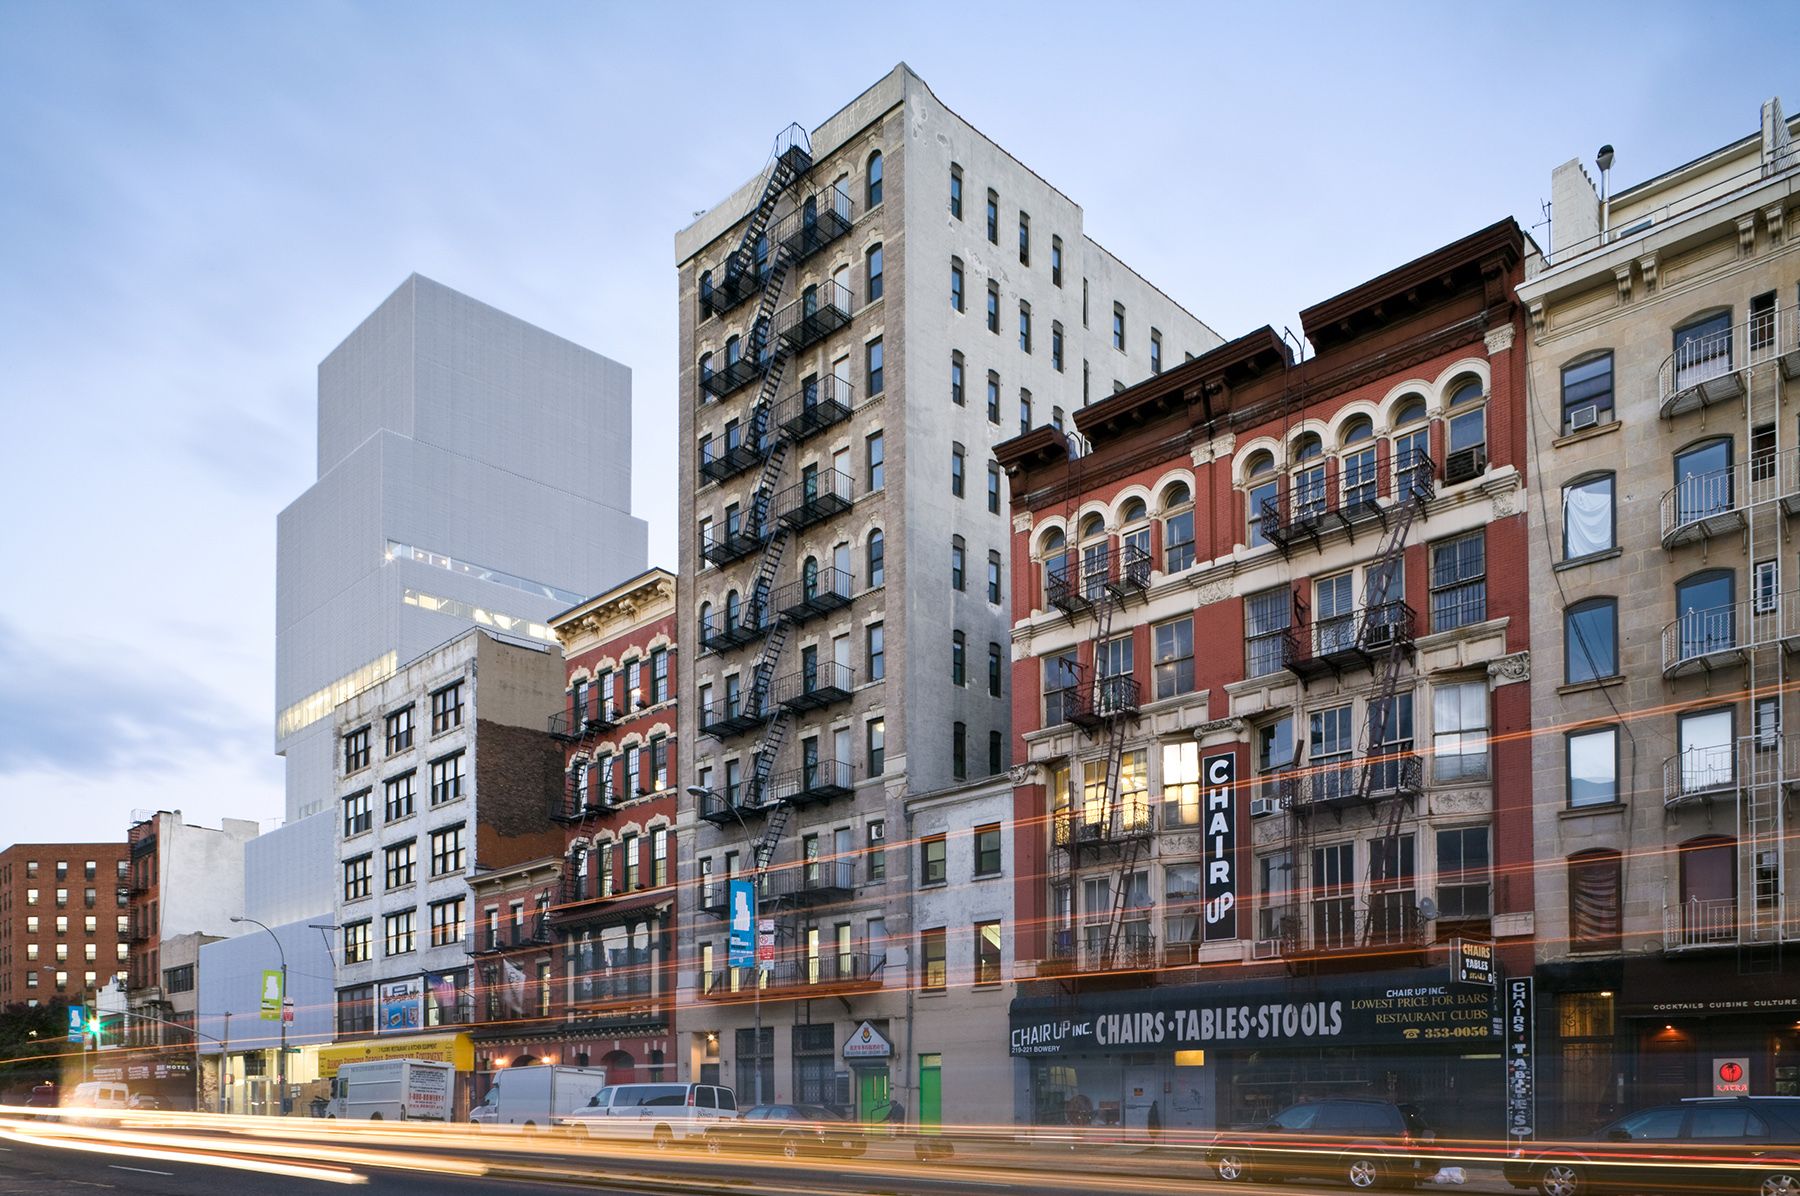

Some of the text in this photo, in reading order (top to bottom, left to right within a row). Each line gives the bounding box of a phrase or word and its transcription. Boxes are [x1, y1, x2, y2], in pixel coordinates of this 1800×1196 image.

[1206, 759, 1234, 924] CHAIR UP
[1462, 943, 1491, 958] CHAIRS
[1465, 958, 1489, 971] TABLES
[1386, 987, 1448, 998] CHAIR UP INC.
[1351, 993, 1488, 1010] LOWEST PRICE FOR BARS
[1512, 982, 1526, 1033] CHAIRS
[1754, 998, 1798, 1007] CULTURE
[1096, 1001, 1343, 1045] CHAIRS TABLES STOOLS
[1376, 1009, 1489, 1024] RESTAURANT CLUBS
[1012, 1020, 1093, 1048] CHAIR UP INC.
[1424, 1026, 1489, 1039] 353-0056
[1034, 1045, 1060, 1053] BOWERY
